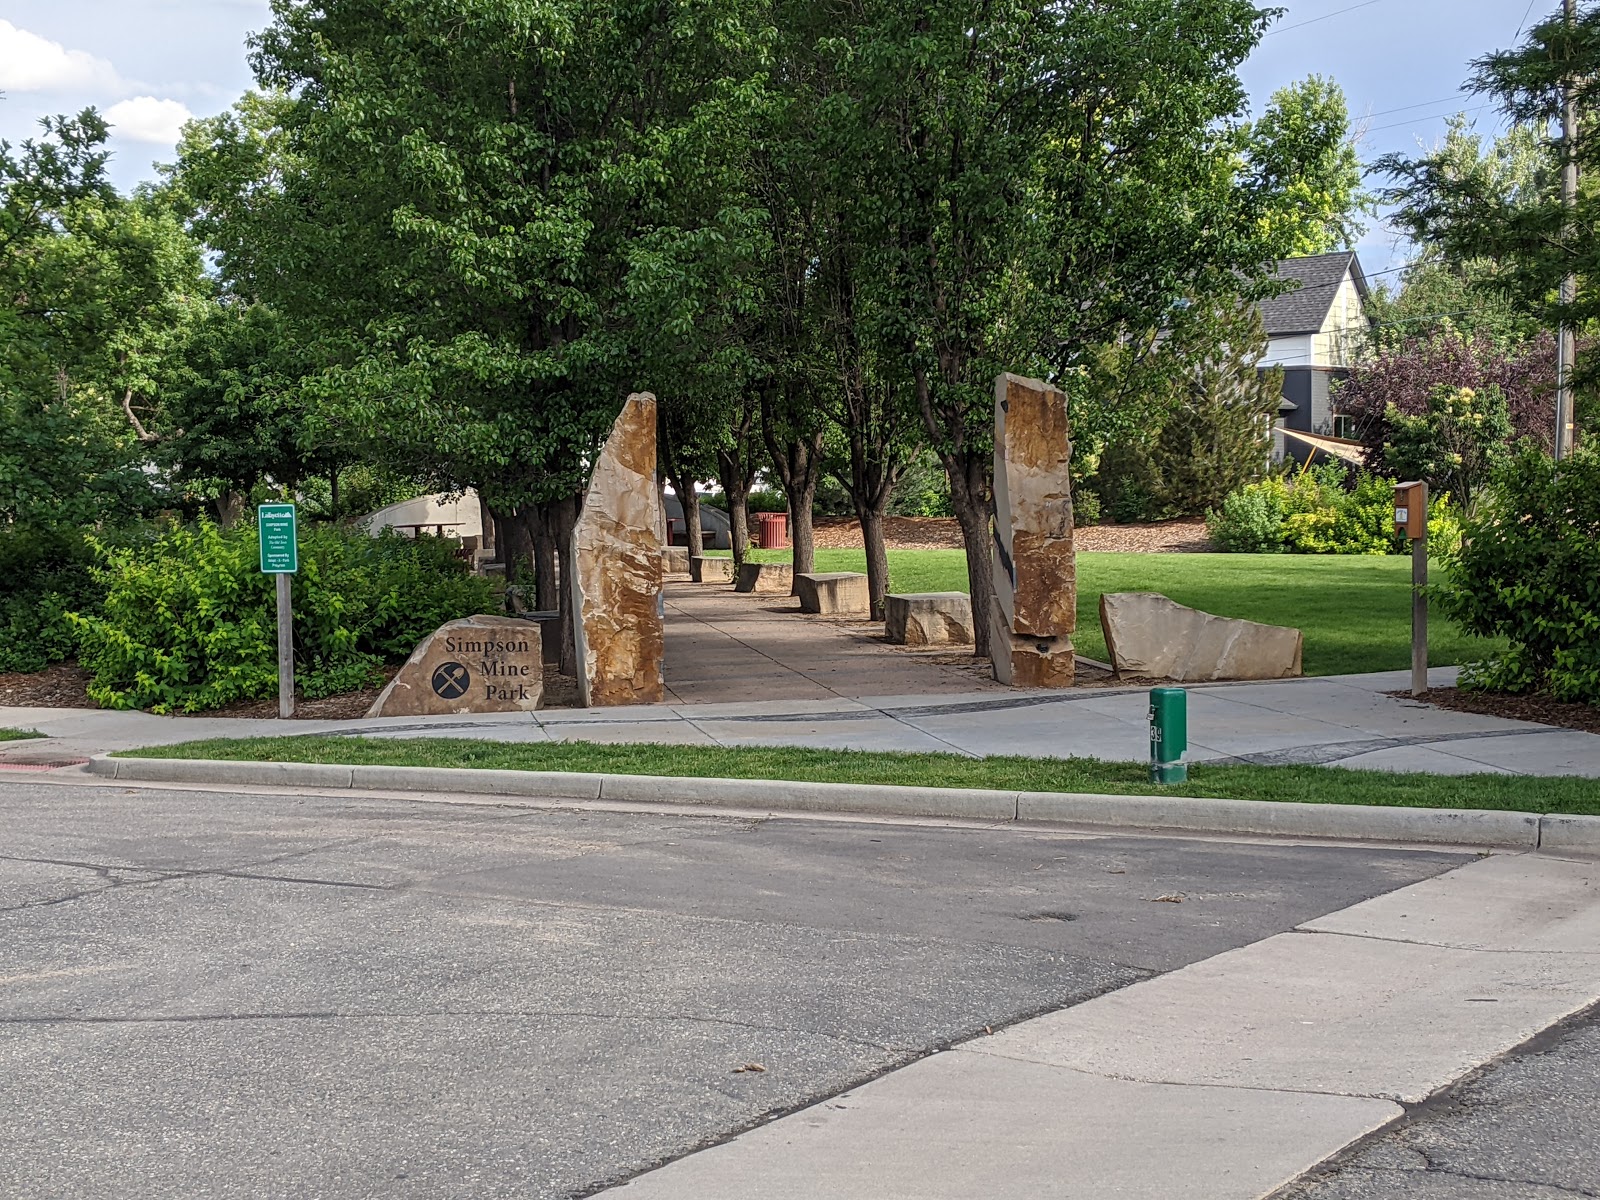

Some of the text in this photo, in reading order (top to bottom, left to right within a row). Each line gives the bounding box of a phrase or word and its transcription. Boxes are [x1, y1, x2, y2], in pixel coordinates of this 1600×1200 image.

[445, 637, 529, 657] Simpson
[481, 661, 530, 676] Mine
[485, 684, 530, 700] Park
